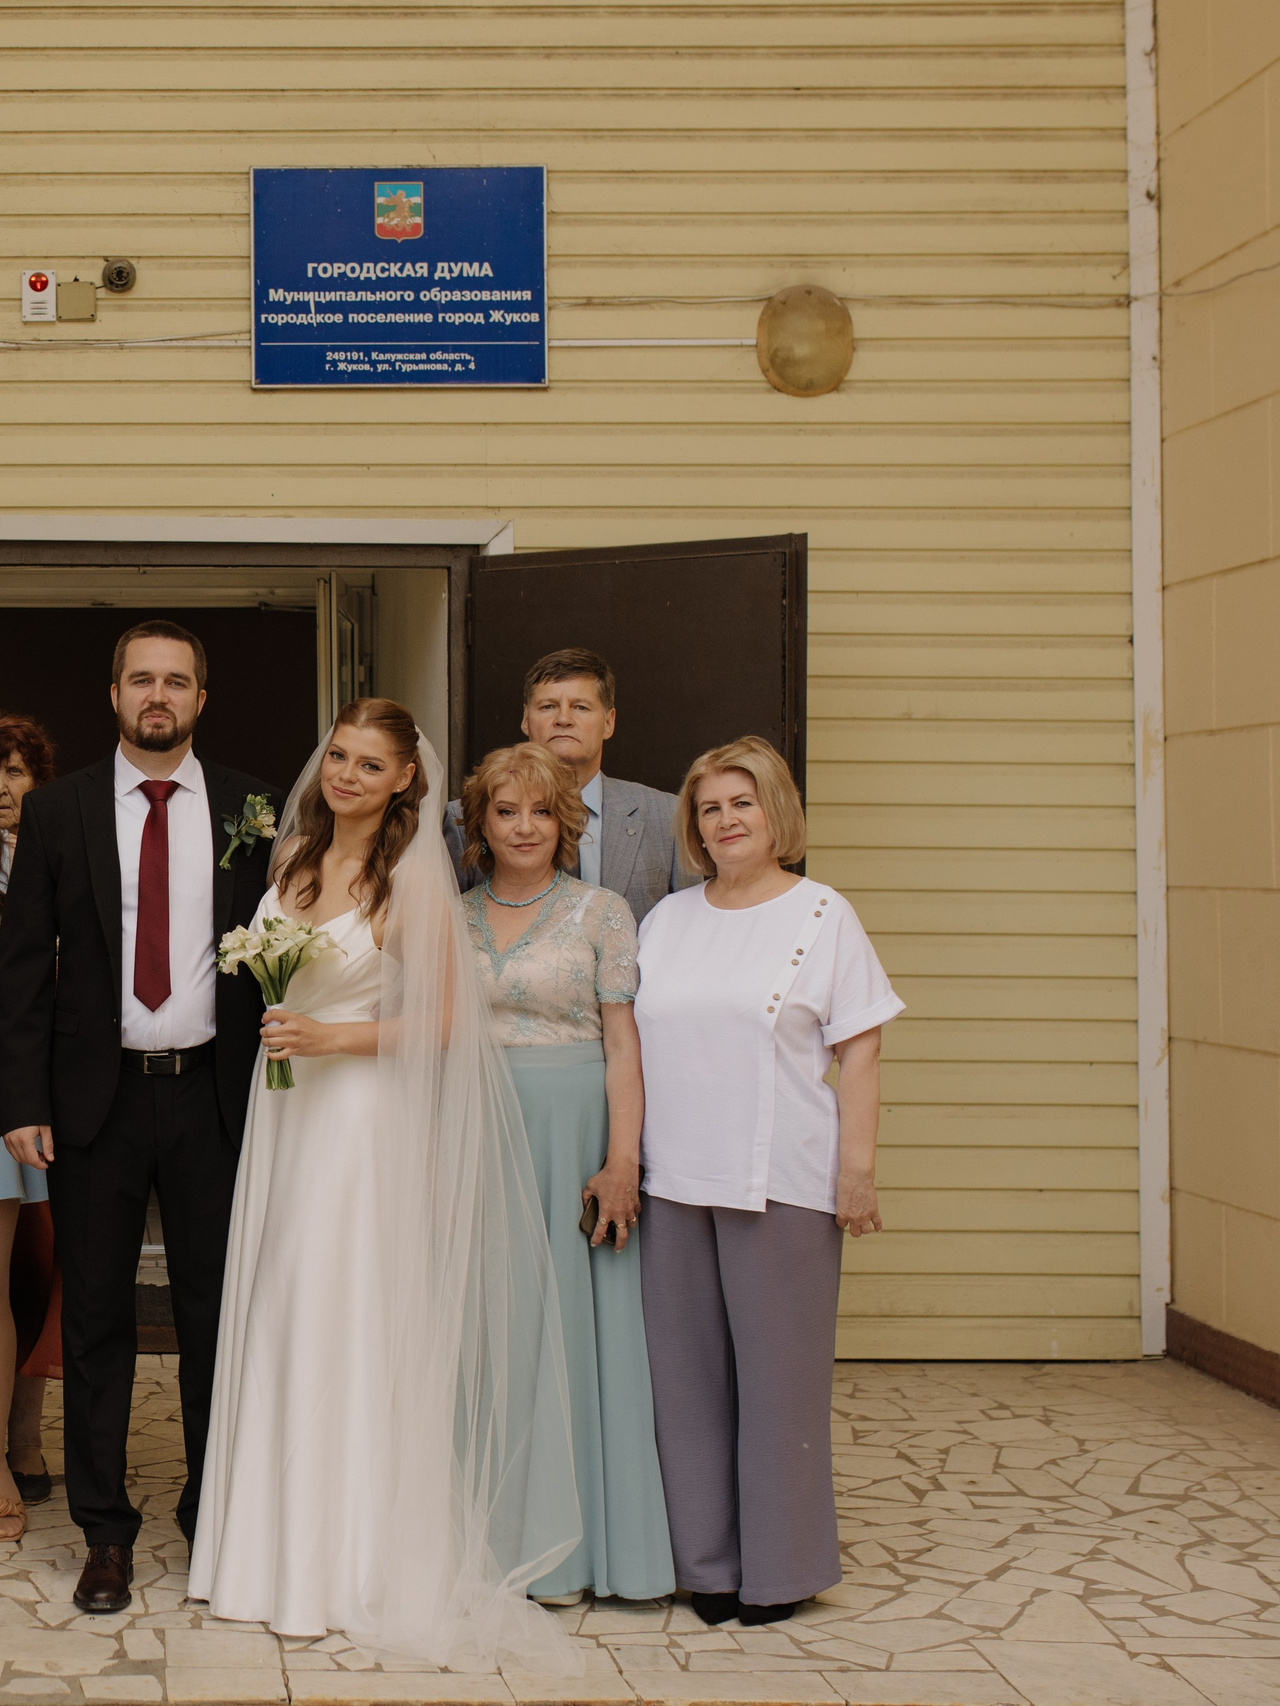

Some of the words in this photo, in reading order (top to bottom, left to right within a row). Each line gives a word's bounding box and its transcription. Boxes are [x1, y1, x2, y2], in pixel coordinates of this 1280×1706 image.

[307, 262, 428, 280] ГОРОДСКАЯ
[434, 262, 494, 280] ДУМА
[268, 288, 415, 304] Муниципального
[419, 287, 532, 303] образования
[260, 312, 344, 325] городское
[348, 312, 434, 323] поселение
[438, 312, 485, 325] город
[489, 310, 540, 325] Жуков
[326, 352, 368, 361] 249191,
[371, 352, 427, 361] Калужская
[429, 350, 475, 361] область,
[337, 362, 374, 372] Жуков,
[376, 364, 393, 372] ул.
[395, 362, 452, 372] Гурьянова,
[454, 364, 466, 372] д.
[468, 362, 476, 370] 4
